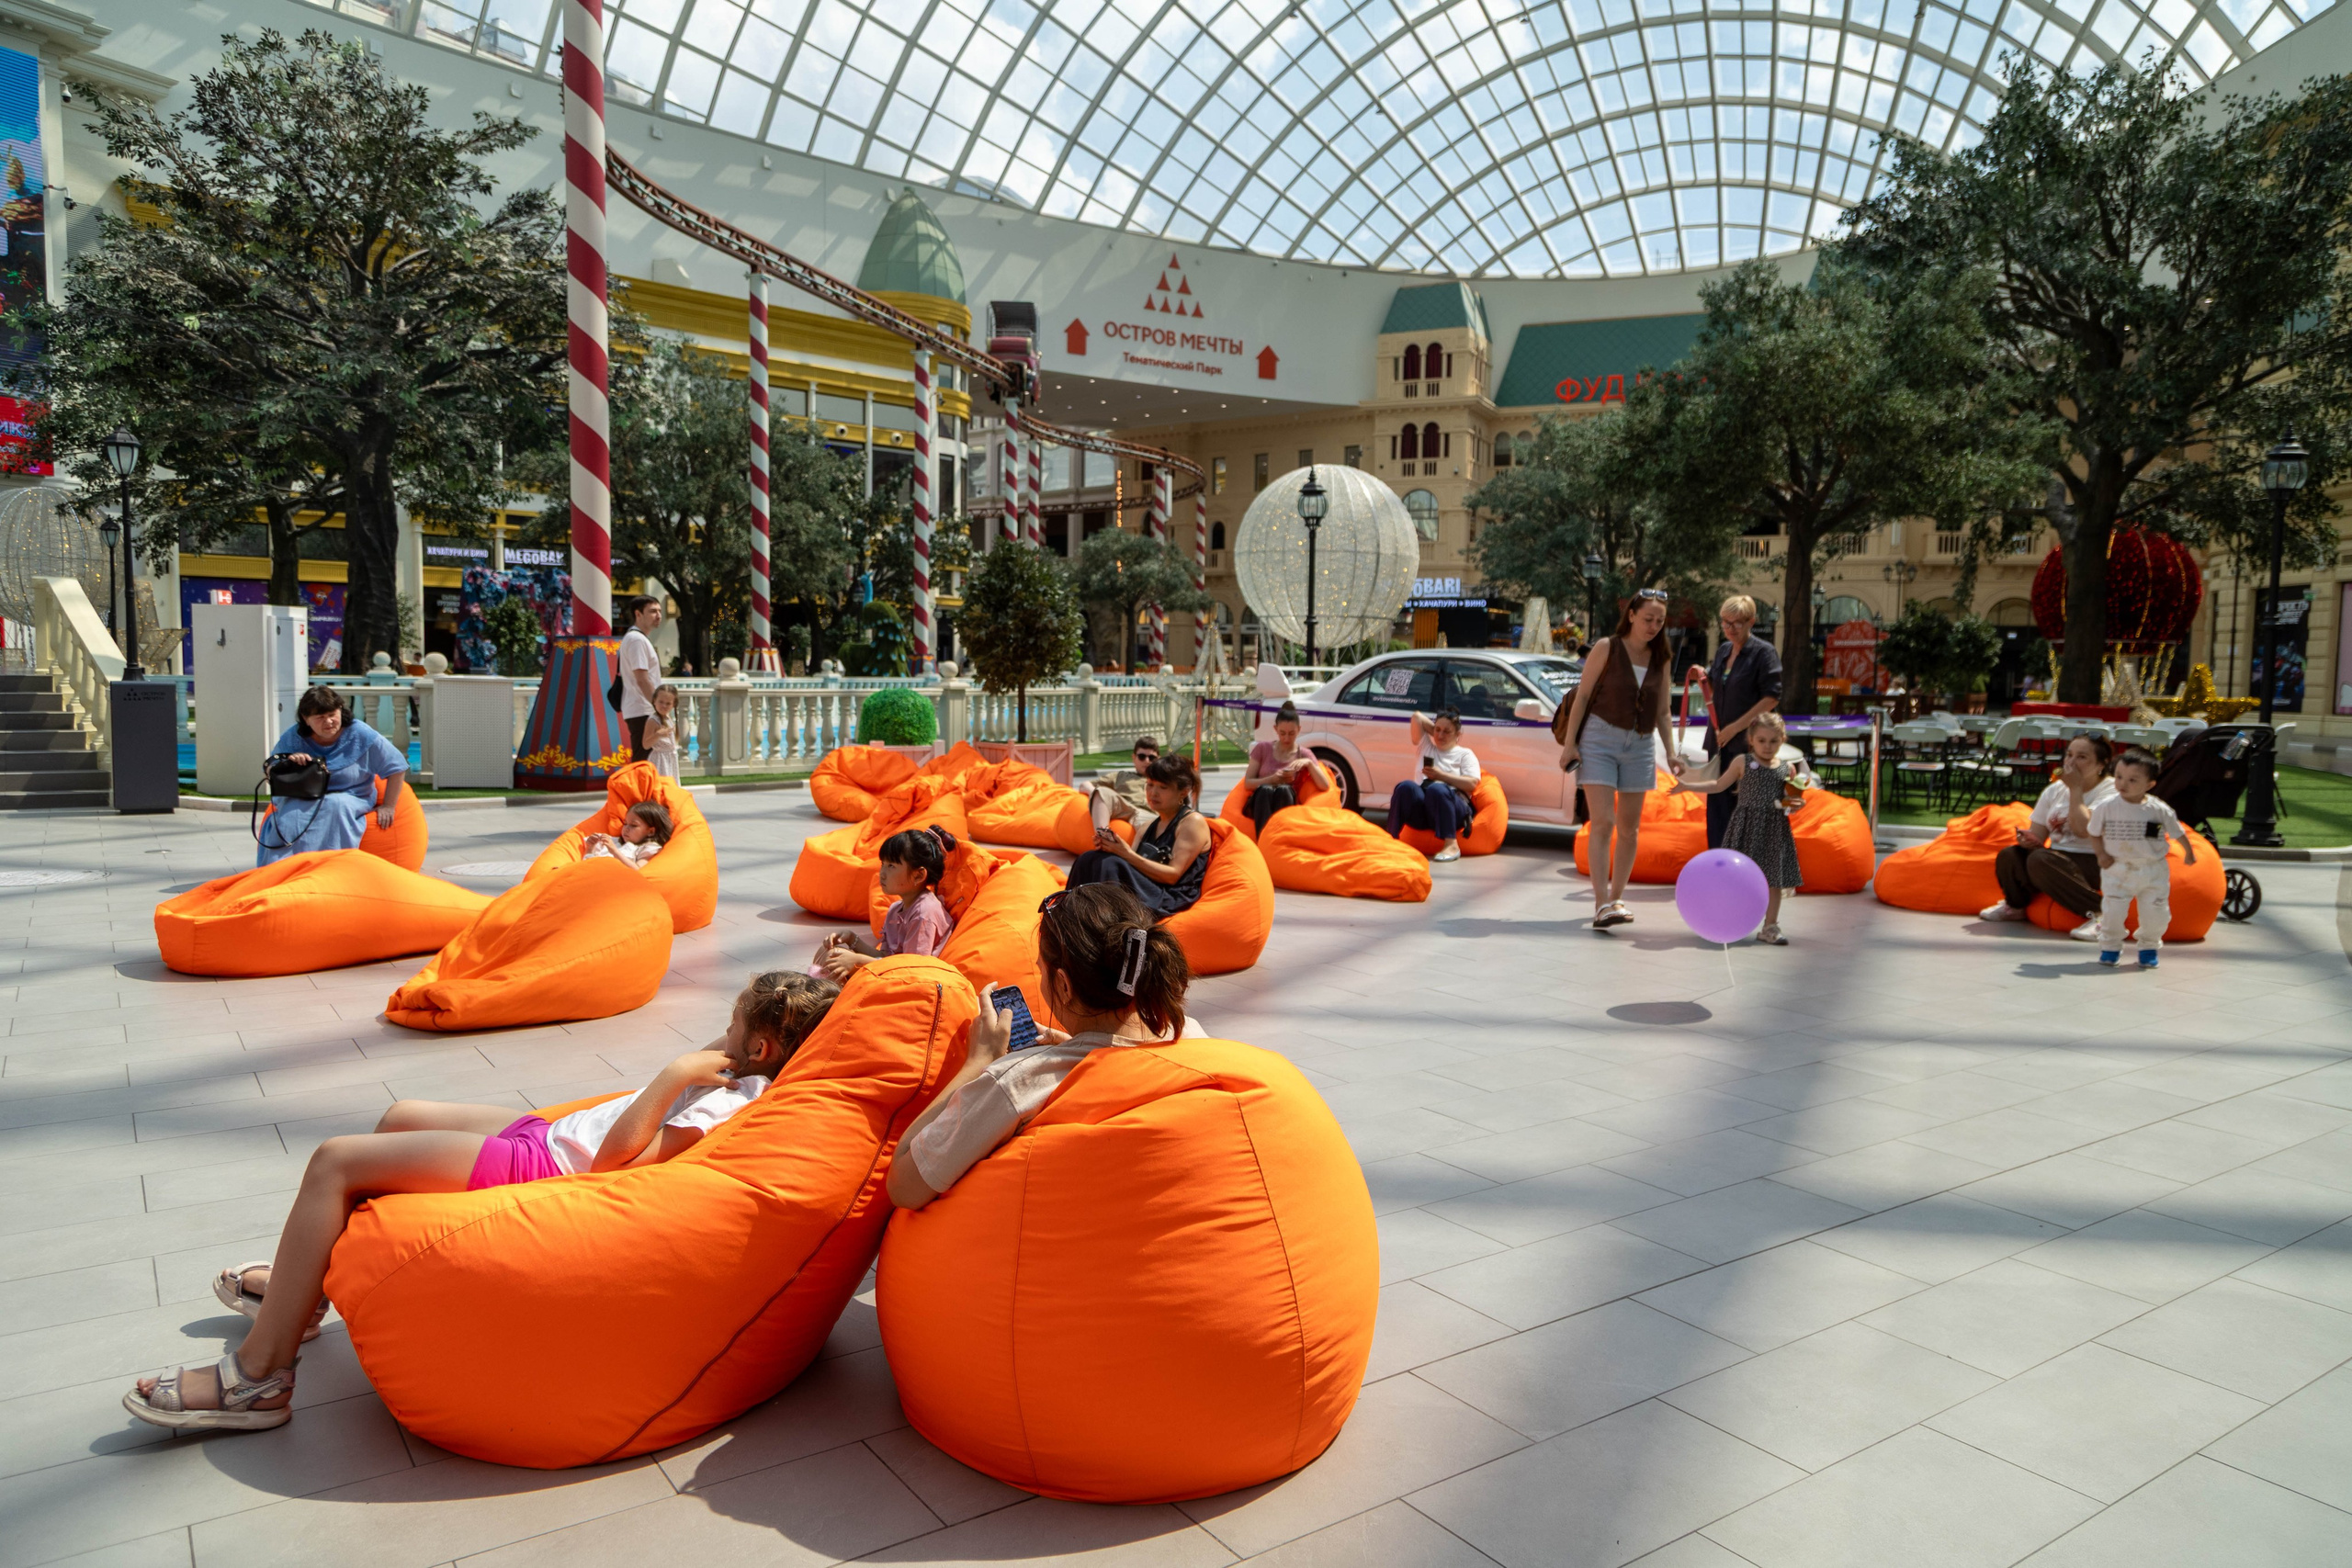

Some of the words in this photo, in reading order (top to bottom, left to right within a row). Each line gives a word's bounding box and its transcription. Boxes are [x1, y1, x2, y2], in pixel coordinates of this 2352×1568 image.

[1104, 321, 1176, 346] ОСТРОВ
[1181, 333, 1243, 355] МЕЧТЫ
[1124, 352, 1194, 371] Тематический
[1196, 362, 1223, 376] Парк
[1555, 374, 1625, 405] ФУД
[1419, 600, 1458, 608] ХАЧАПУРИ
[1464, 599, 1487, 608] ВИНО
